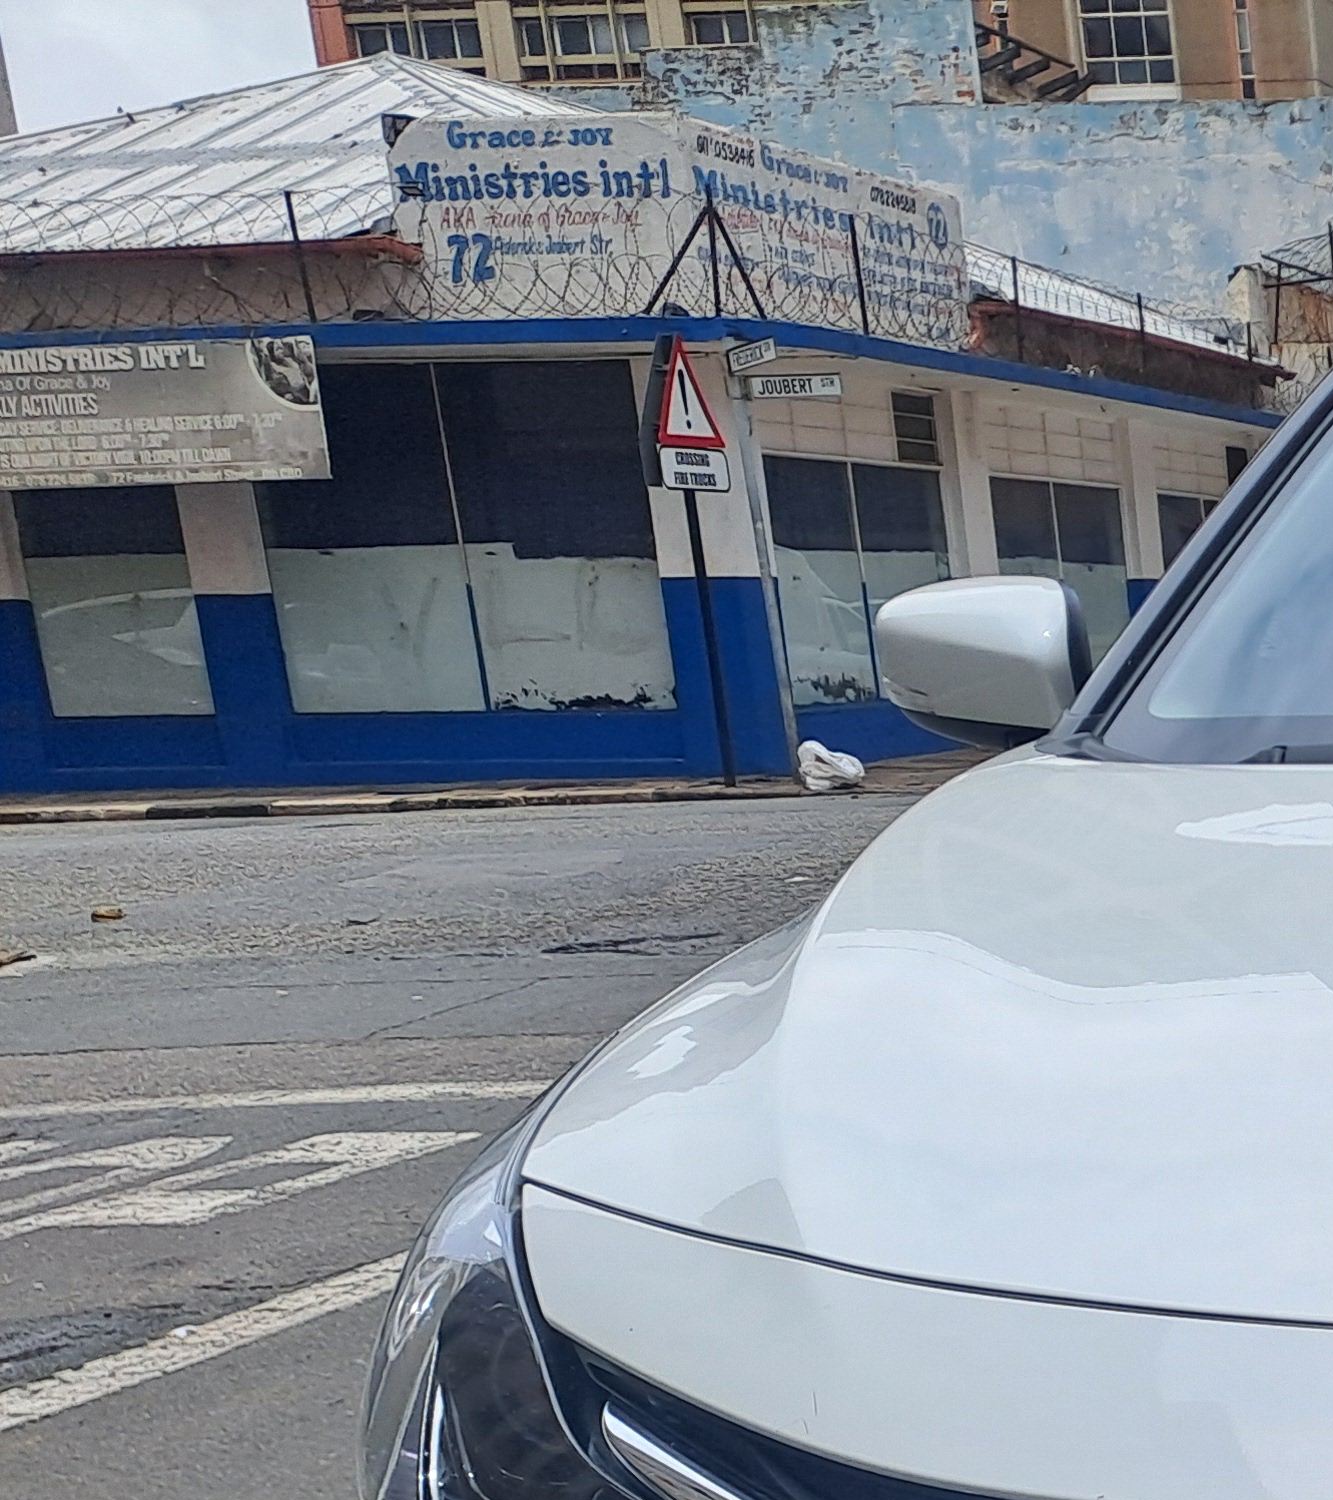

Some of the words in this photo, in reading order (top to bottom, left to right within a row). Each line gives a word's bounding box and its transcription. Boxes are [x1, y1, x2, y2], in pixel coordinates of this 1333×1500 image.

[447, 120, 535, 149] Grace
[567, 127, 612, 146] JOY
[395, 161, 590, 202] Ministries
[447, 233, 496, 284] 72
[0, 347, 134, 374] MINISTRIES
[140, 344, 206, 370] INT'L
[34, 376, 75, 390] Grace
[758, 378, 813, 396] JOUBERT
[0, 396, 17, 416] LY
[21, 393, 98, 416] ACTIVITIES
[174, 415, 213, 430] SERVICE
[675, 451, 710, 467] CROSSING
[674, 471, 689, 485] FIRE
[689, 472, 717, 486] TRUCKS
